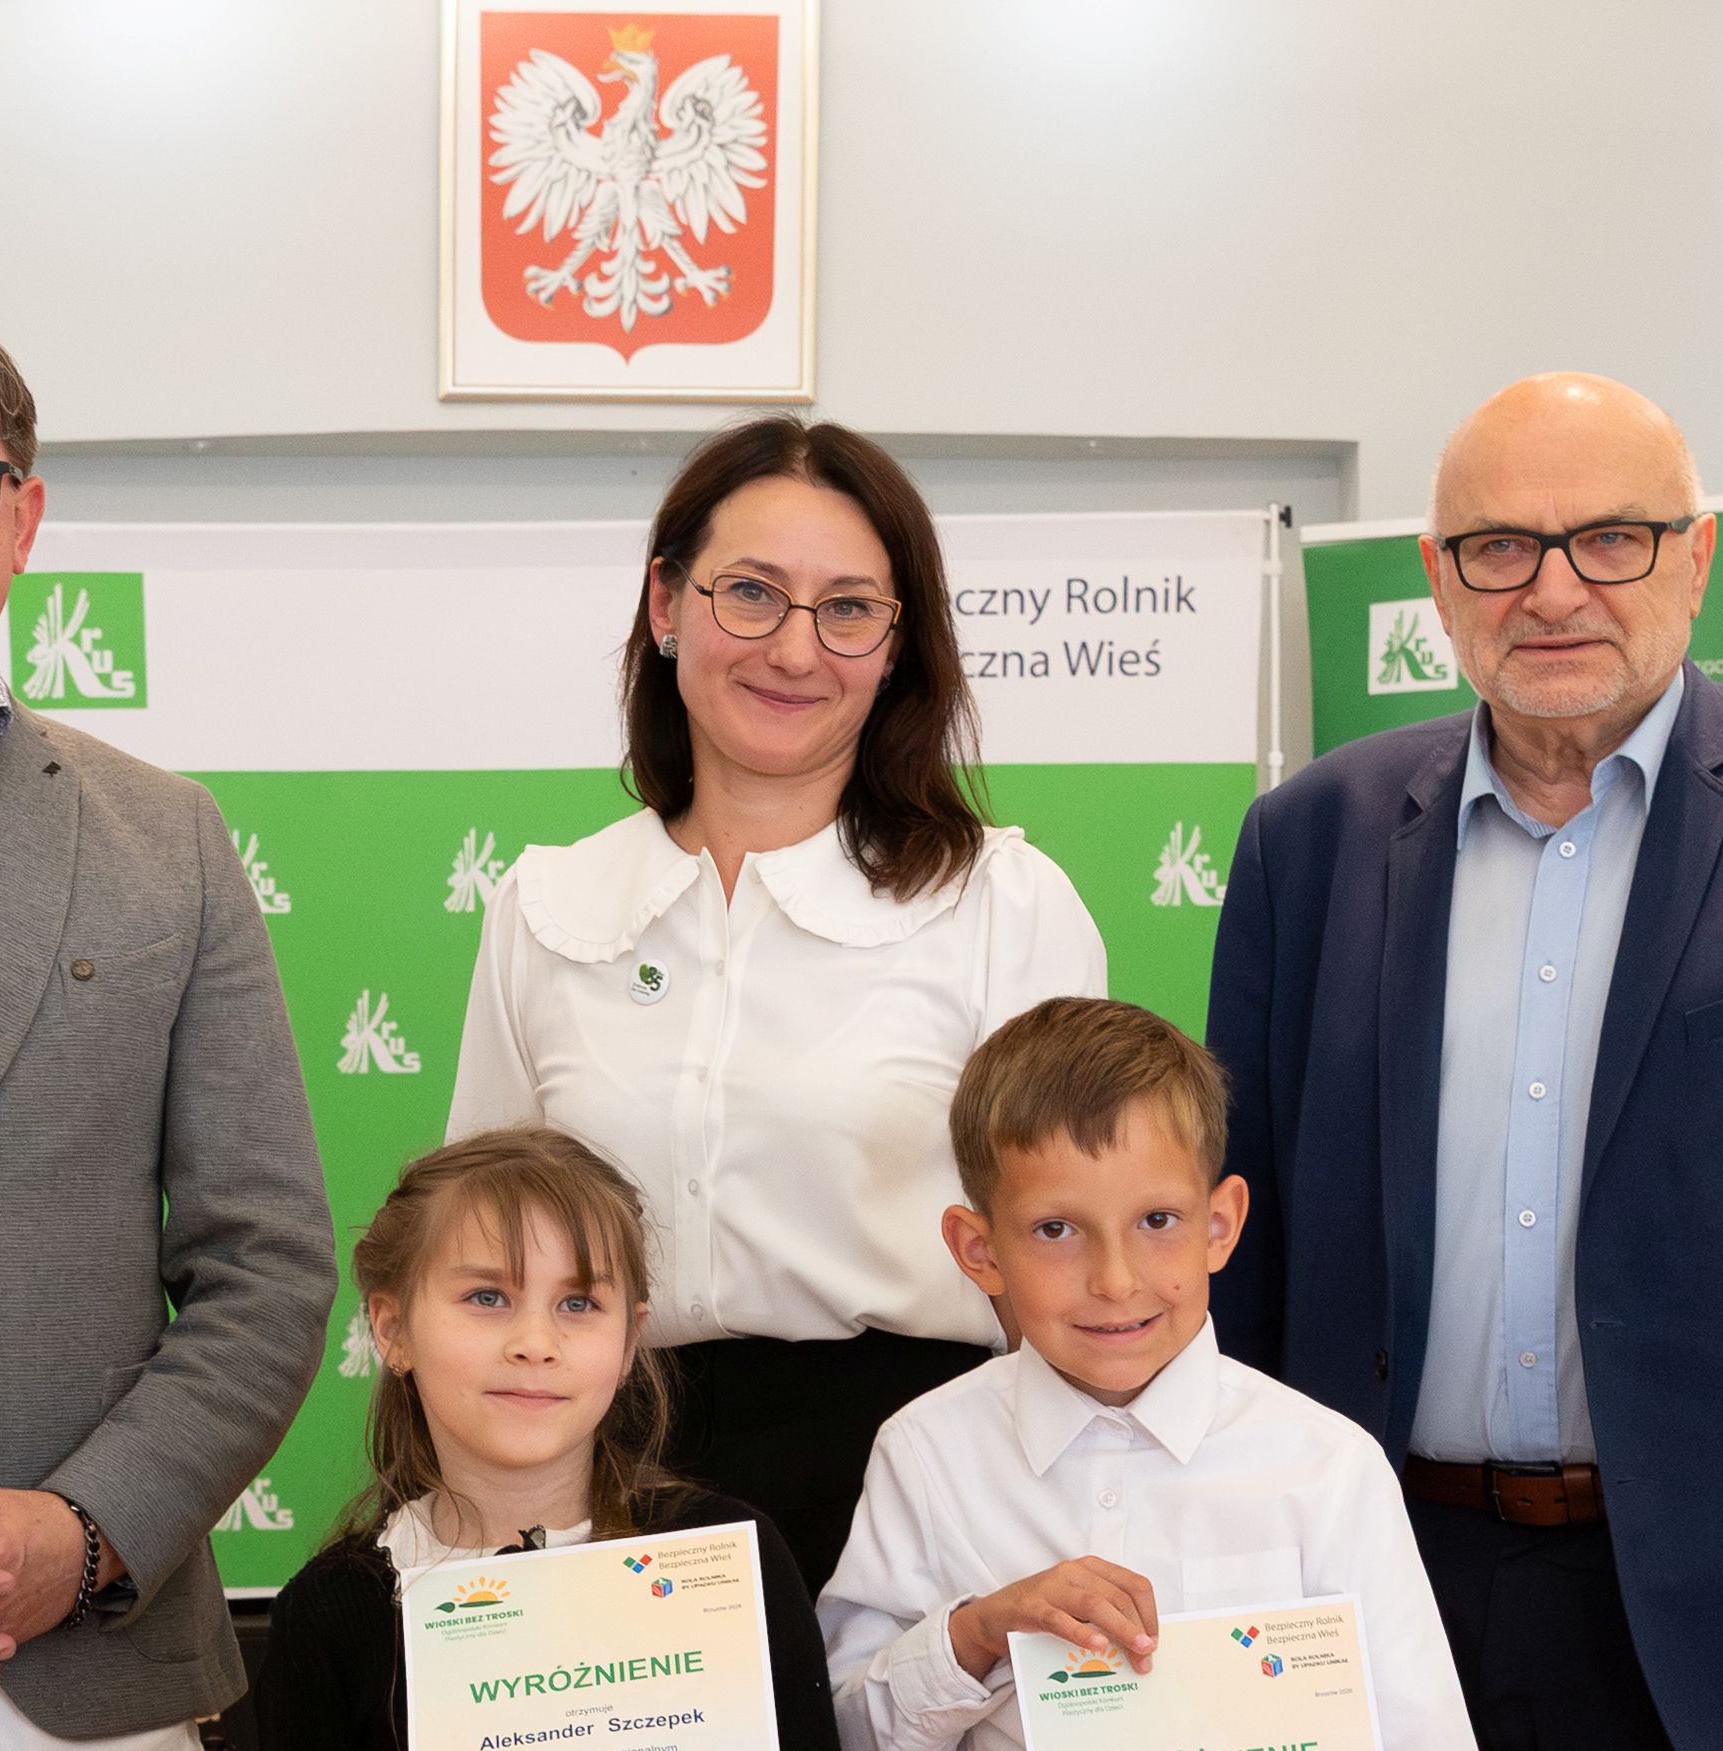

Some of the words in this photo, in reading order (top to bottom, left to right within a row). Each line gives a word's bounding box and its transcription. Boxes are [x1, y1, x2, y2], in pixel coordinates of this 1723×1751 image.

[1066, 575, 1196, 614] Rolnik
[1063, 638, 1161, 677] Wieś
[424, 1618, 463, 1630] WIOSKI
[465, 1614, 484, 1624] BEZ
[485, 1609, 524, 1621] TROSKI
[1264, 1619, 1314, 1633] Bezpieczny
[1266, 1631, 1317, 1645] Bezpieczna
[469, 1650, 705, 1704] WYRÓŻNIENIE
[1039, 1689, 1079, 1702] WIOSKI
[1080, 1686, 1099, 1697] BEZ
[1100, 1682, 1139, 1694] TROSKI
[565, 1704, 614, 1718] otrzymuje
[480, 1723, 595, 1751] Aleksander
[607, 1708, 706, 1733] Szczepek
